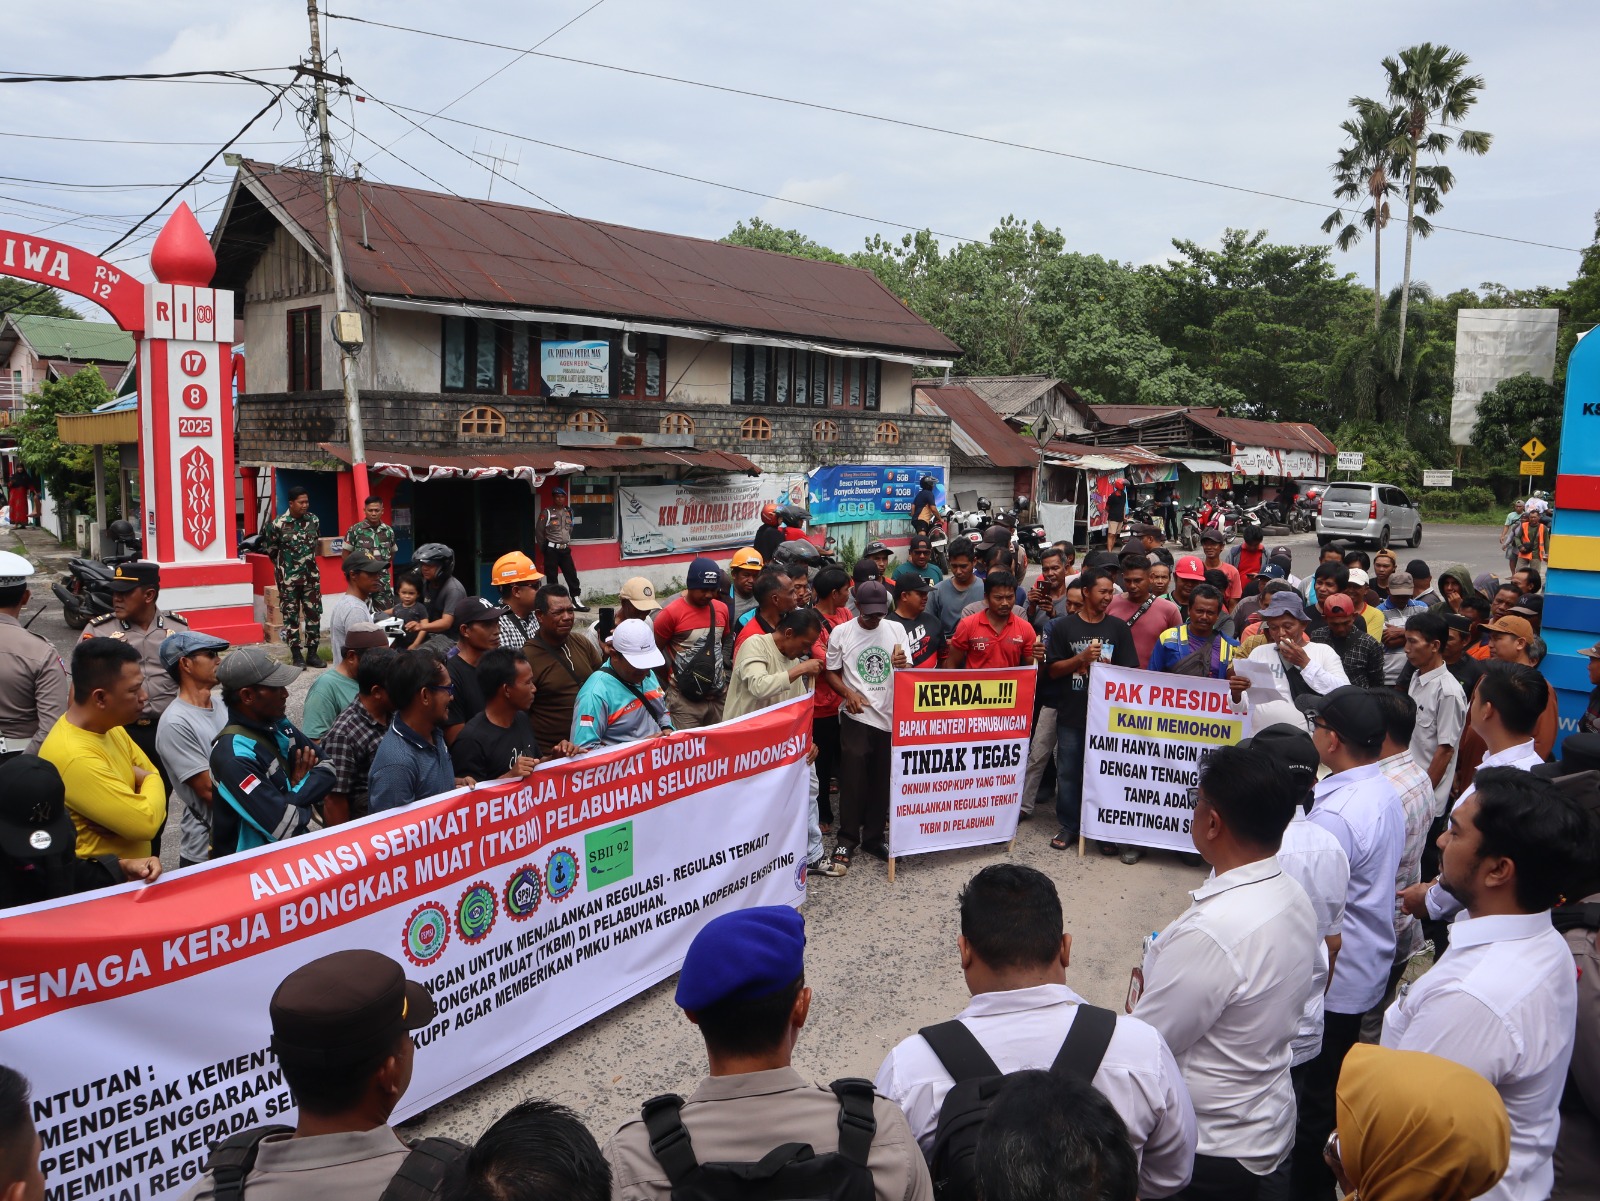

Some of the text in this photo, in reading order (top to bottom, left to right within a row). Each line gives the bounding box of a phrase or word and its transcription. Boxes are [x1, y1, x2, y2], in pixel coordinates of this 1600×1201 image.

[96, 265, 121, 285] RW
[92, 281, 112, 299] 12
[184, 354, 202, 372] 17
[189, 388, 201, 404] 8
[180, 419, 211, 433] 2025
[896, 474, 909, 482] 5GB
[834, 488, 854, 497] Banyak
[895, 488, 911, 496] 10GB
[657, 506, 679, 526] KM.
[682, 502, 729, 526] DHARMA
[894, 502, 912, 511] 20GB
[1105, 681, 1247, 717] PAK PRESIDE
[899, 715, 1027, 738] BAPAK MENTERI PERHUBUNGAN
[1117, 712, 1231, 740] KAMI MEMOHON
[901, 743, 1021, 776] TINDAK TEGAS
[1089, 734, 1118, 752] KAMI
[1121, 738, 1160, 758] HANYA
[1163, 744, 1197, 762] INGIN
[901, 781, 931, 796] OKNUM
[975, 776, 994, 790] YANG
[996, 773, 1016, 788] TIDAK
[1100, 759, 1198, 787] DENGAN TENANG
[896, 792, 1019, 818] MENJALANKAN REGULASI TERKAIT
[1124, 786, 1161, 806] TANPA
[249, 841, 368, 902] ALIANSI
[370, 805, 471, 863] SERIKAT
[474, 777, 558, 828] PEKERJA
[570, 751, 646, 794] SERIKAT
[651, 736, 707, 771] BURUH
[919, 815, 995, 835] TKBM DI PELABUHAN
[1097, 807, 1180, 833] KEPENTINGAN
[616, 840, 629, 855] 92
[0, 947, 152, 1017] TENAGA
[161, 912, 271, 972] KERJA
[279, 865, 409, 934] BONGKAR
[414, 840, 474, 886] MUAT
[478, 818, 543, 867] (TKBM)
[544, 779, 654, 835] PELABUHAN
[657, 756, 729, 798] SELURUH
[733, 732, 807, 774] INDONESIA
[517, 887, 531, 901] SPSI
[38, 1079, 181, 1153] MENDESAK
[468, 944, 513, 976] UNTUK
[516, 893, 604, 958] MENJALANKAN
[605, 872, 664, 909] REGULASI
[673, 849, 727, 883] REGULASI
[729, 832, 770, 861] TERKAIT
[39, 1067, 283, 1182] PENYELENGGARAAN
[499, 953, 533, 988] MUAT
[535, 929, 577, 967] (TKBM)
[579, 924, 591, 942] DI
[594, 892, 668, 933] PELABUHAN.
[44, 1138, 164, 1201] MEMINTA
[171, 1108, 260, 1160] KEPADA
[453, 1002, 493, 1031] AGAR
[495, 958, 573, 1010] MEMBERIKAN
[575, 938, 610, 968] PMKU
[613, 916, 654, 947] HANYA
[655, 898, 701, 928] KEPADA
[702, 875, 749, 912] KOPERASI
[750, 851, 795, 886] EKSISTING
